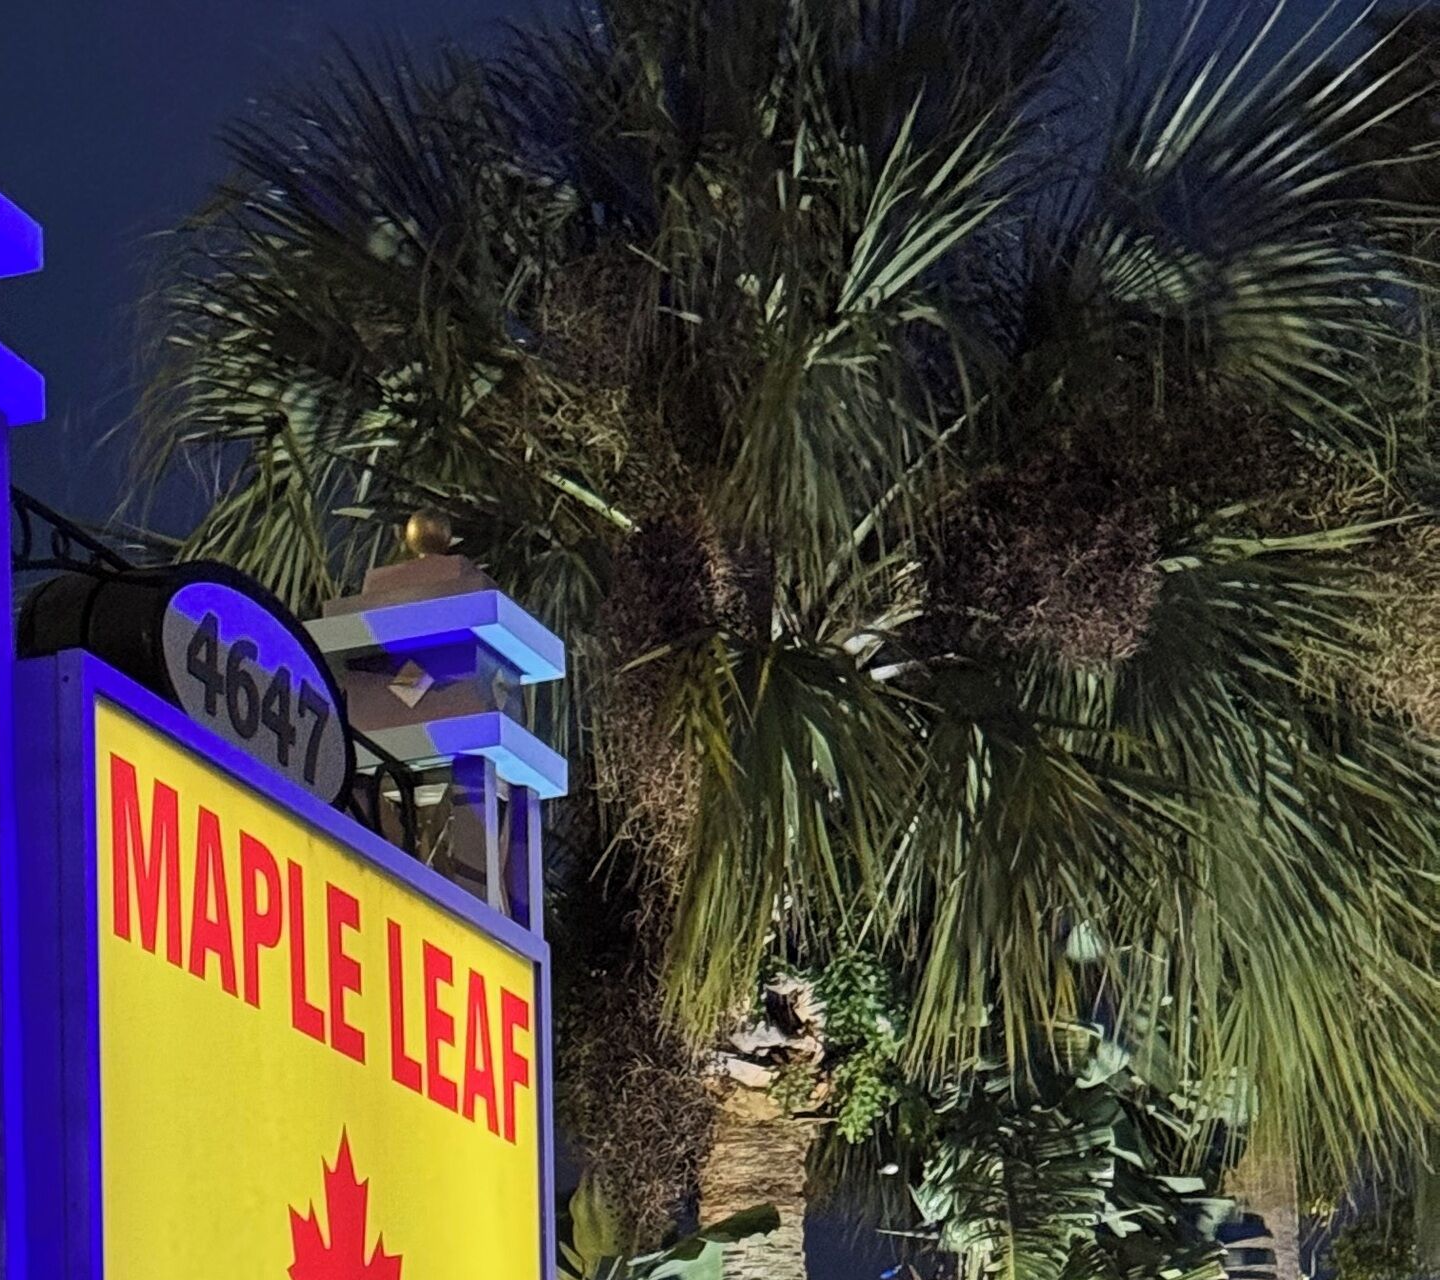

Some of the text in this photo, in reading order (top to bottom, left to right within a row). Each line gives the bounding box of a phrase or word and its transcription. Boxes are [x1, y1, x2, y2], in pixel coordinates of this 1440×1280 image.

[186, 611, 331, 786] 4647
[109, 751, 530, 1146] MAPLE LEAF
